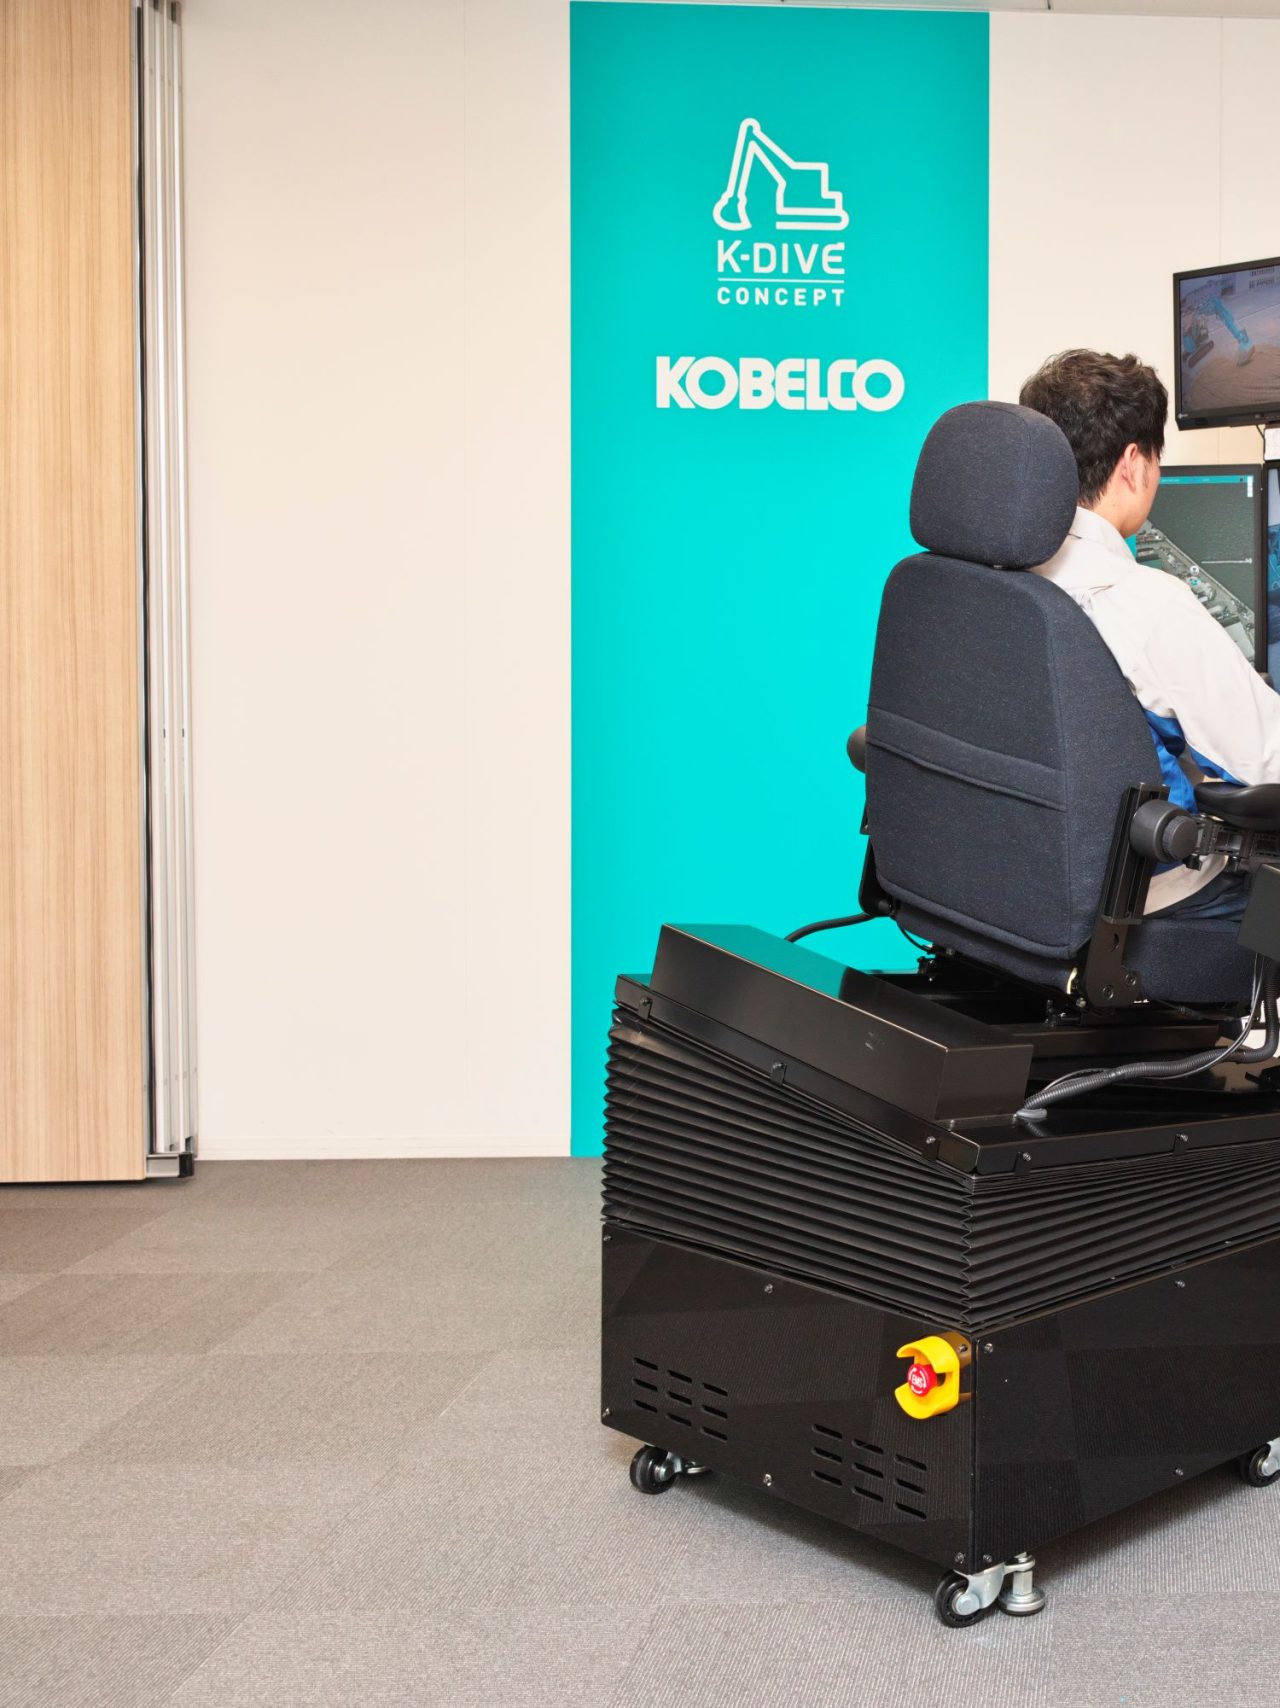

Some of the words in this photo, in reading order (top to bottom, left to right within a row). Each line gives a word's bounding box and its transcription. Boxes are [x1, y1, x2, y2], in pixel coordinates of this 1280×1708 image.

[717, 239, 845, 275] K-DIVE
[717, 286, 845, 306] CONCEPT
[656, 355, 905, 412] KOBELCO
